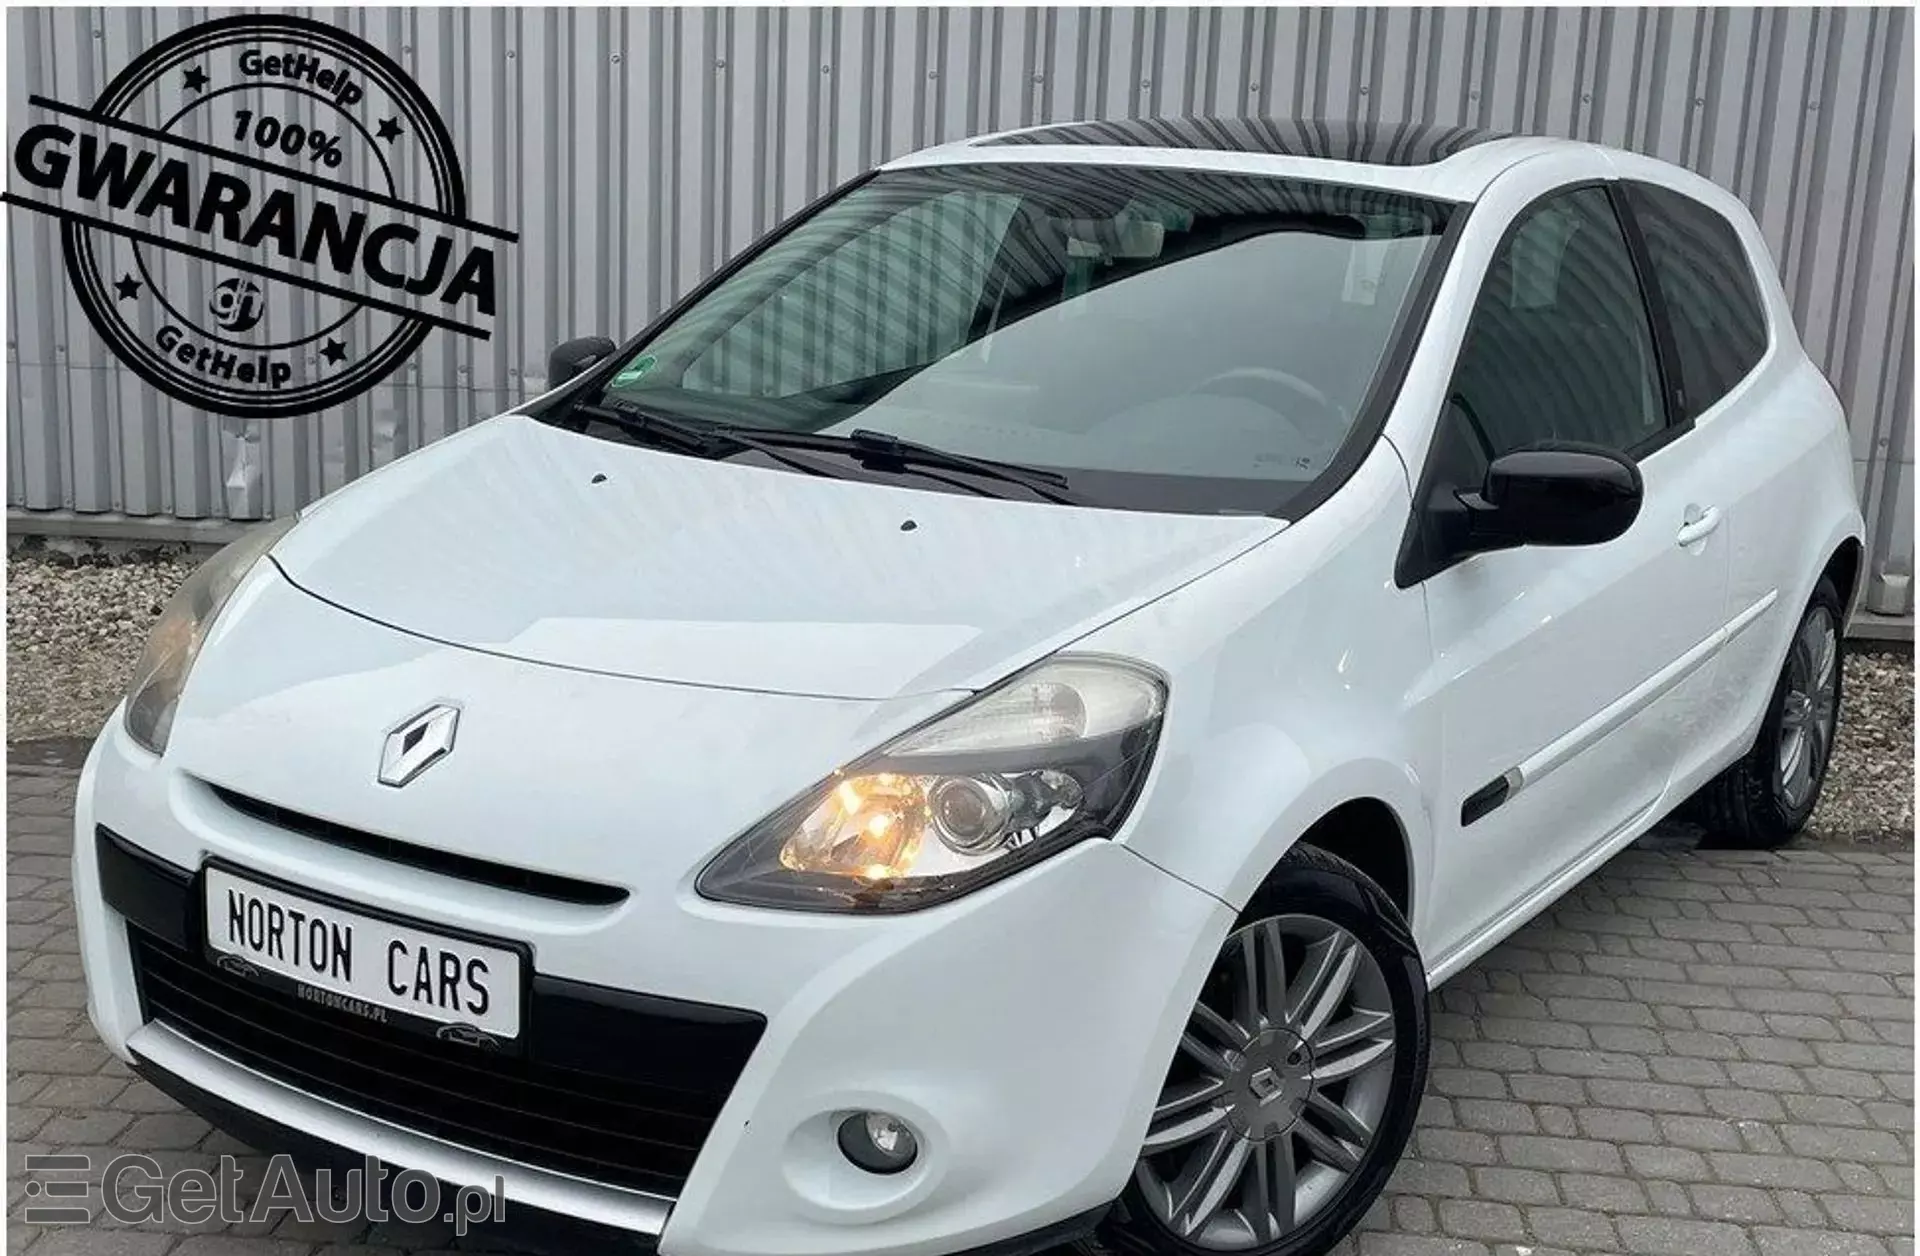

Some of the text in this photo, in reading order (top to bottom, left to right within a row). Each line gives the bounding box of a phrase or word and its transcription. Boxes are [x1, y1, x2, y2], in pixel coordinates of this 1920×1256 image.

[228, 888, 489, 1016] NORTON CARS
[297, 984, 389, 1024] NORTONCARS.PL
